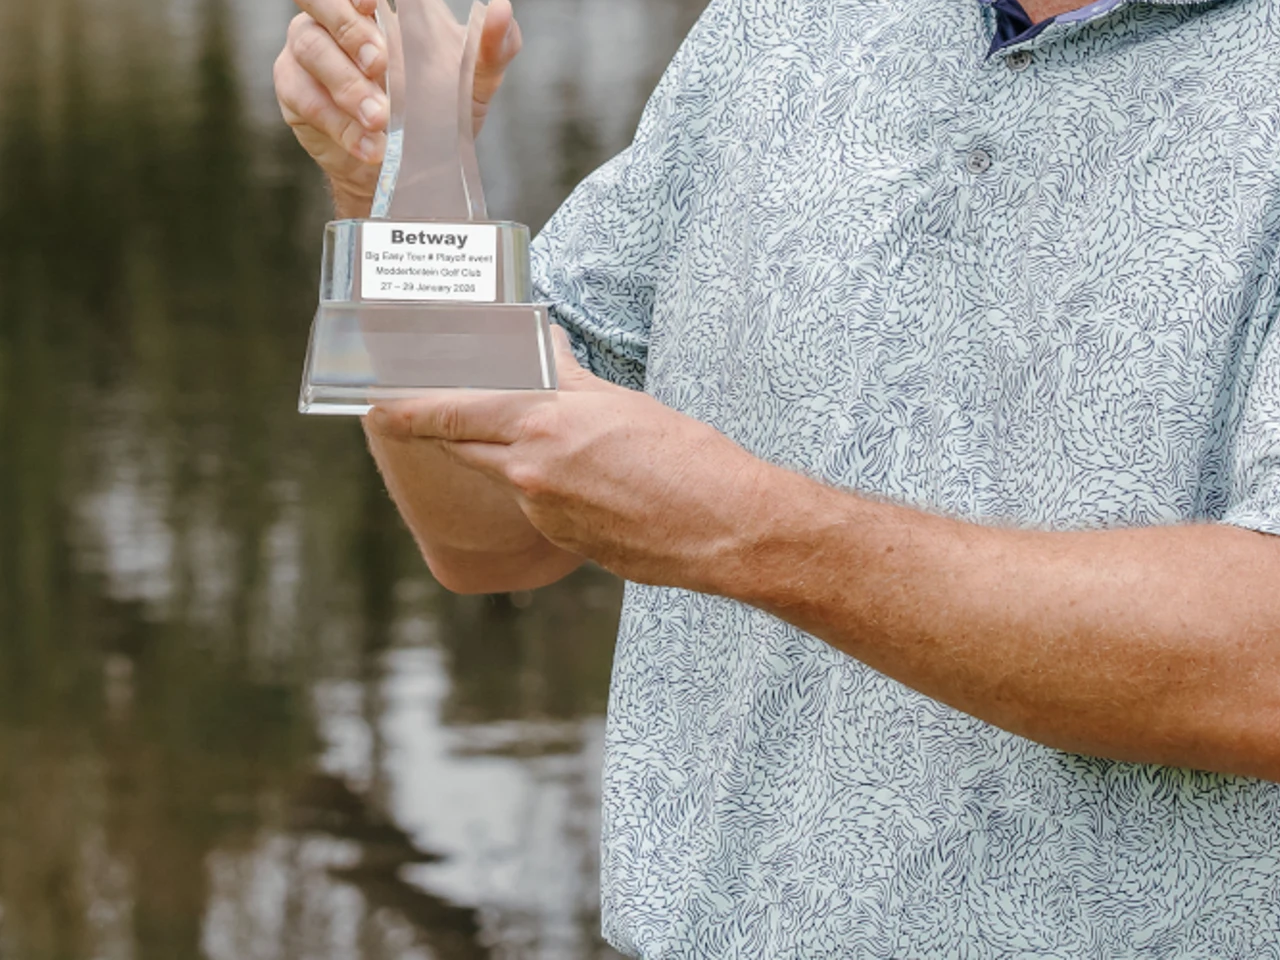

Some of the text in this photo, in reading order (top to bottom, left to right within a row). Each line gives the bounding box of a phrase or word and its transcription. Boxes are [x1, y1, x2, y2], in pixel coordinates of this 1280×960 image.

[391, 230, 468, 249] Betway
[365, 252, 379, 261] Big
[382, 252, 404, 262] Easy
[407, 252, 426, 261] Tour
[436, 254, 466, 263] Playoff
[468, 254, 493, 263] event
[440, 267, 459, 277] Golf
[461, 268, 481, 277] Club
[380, 282, 392, 291] 27
[416, 283, 452, 294] January
